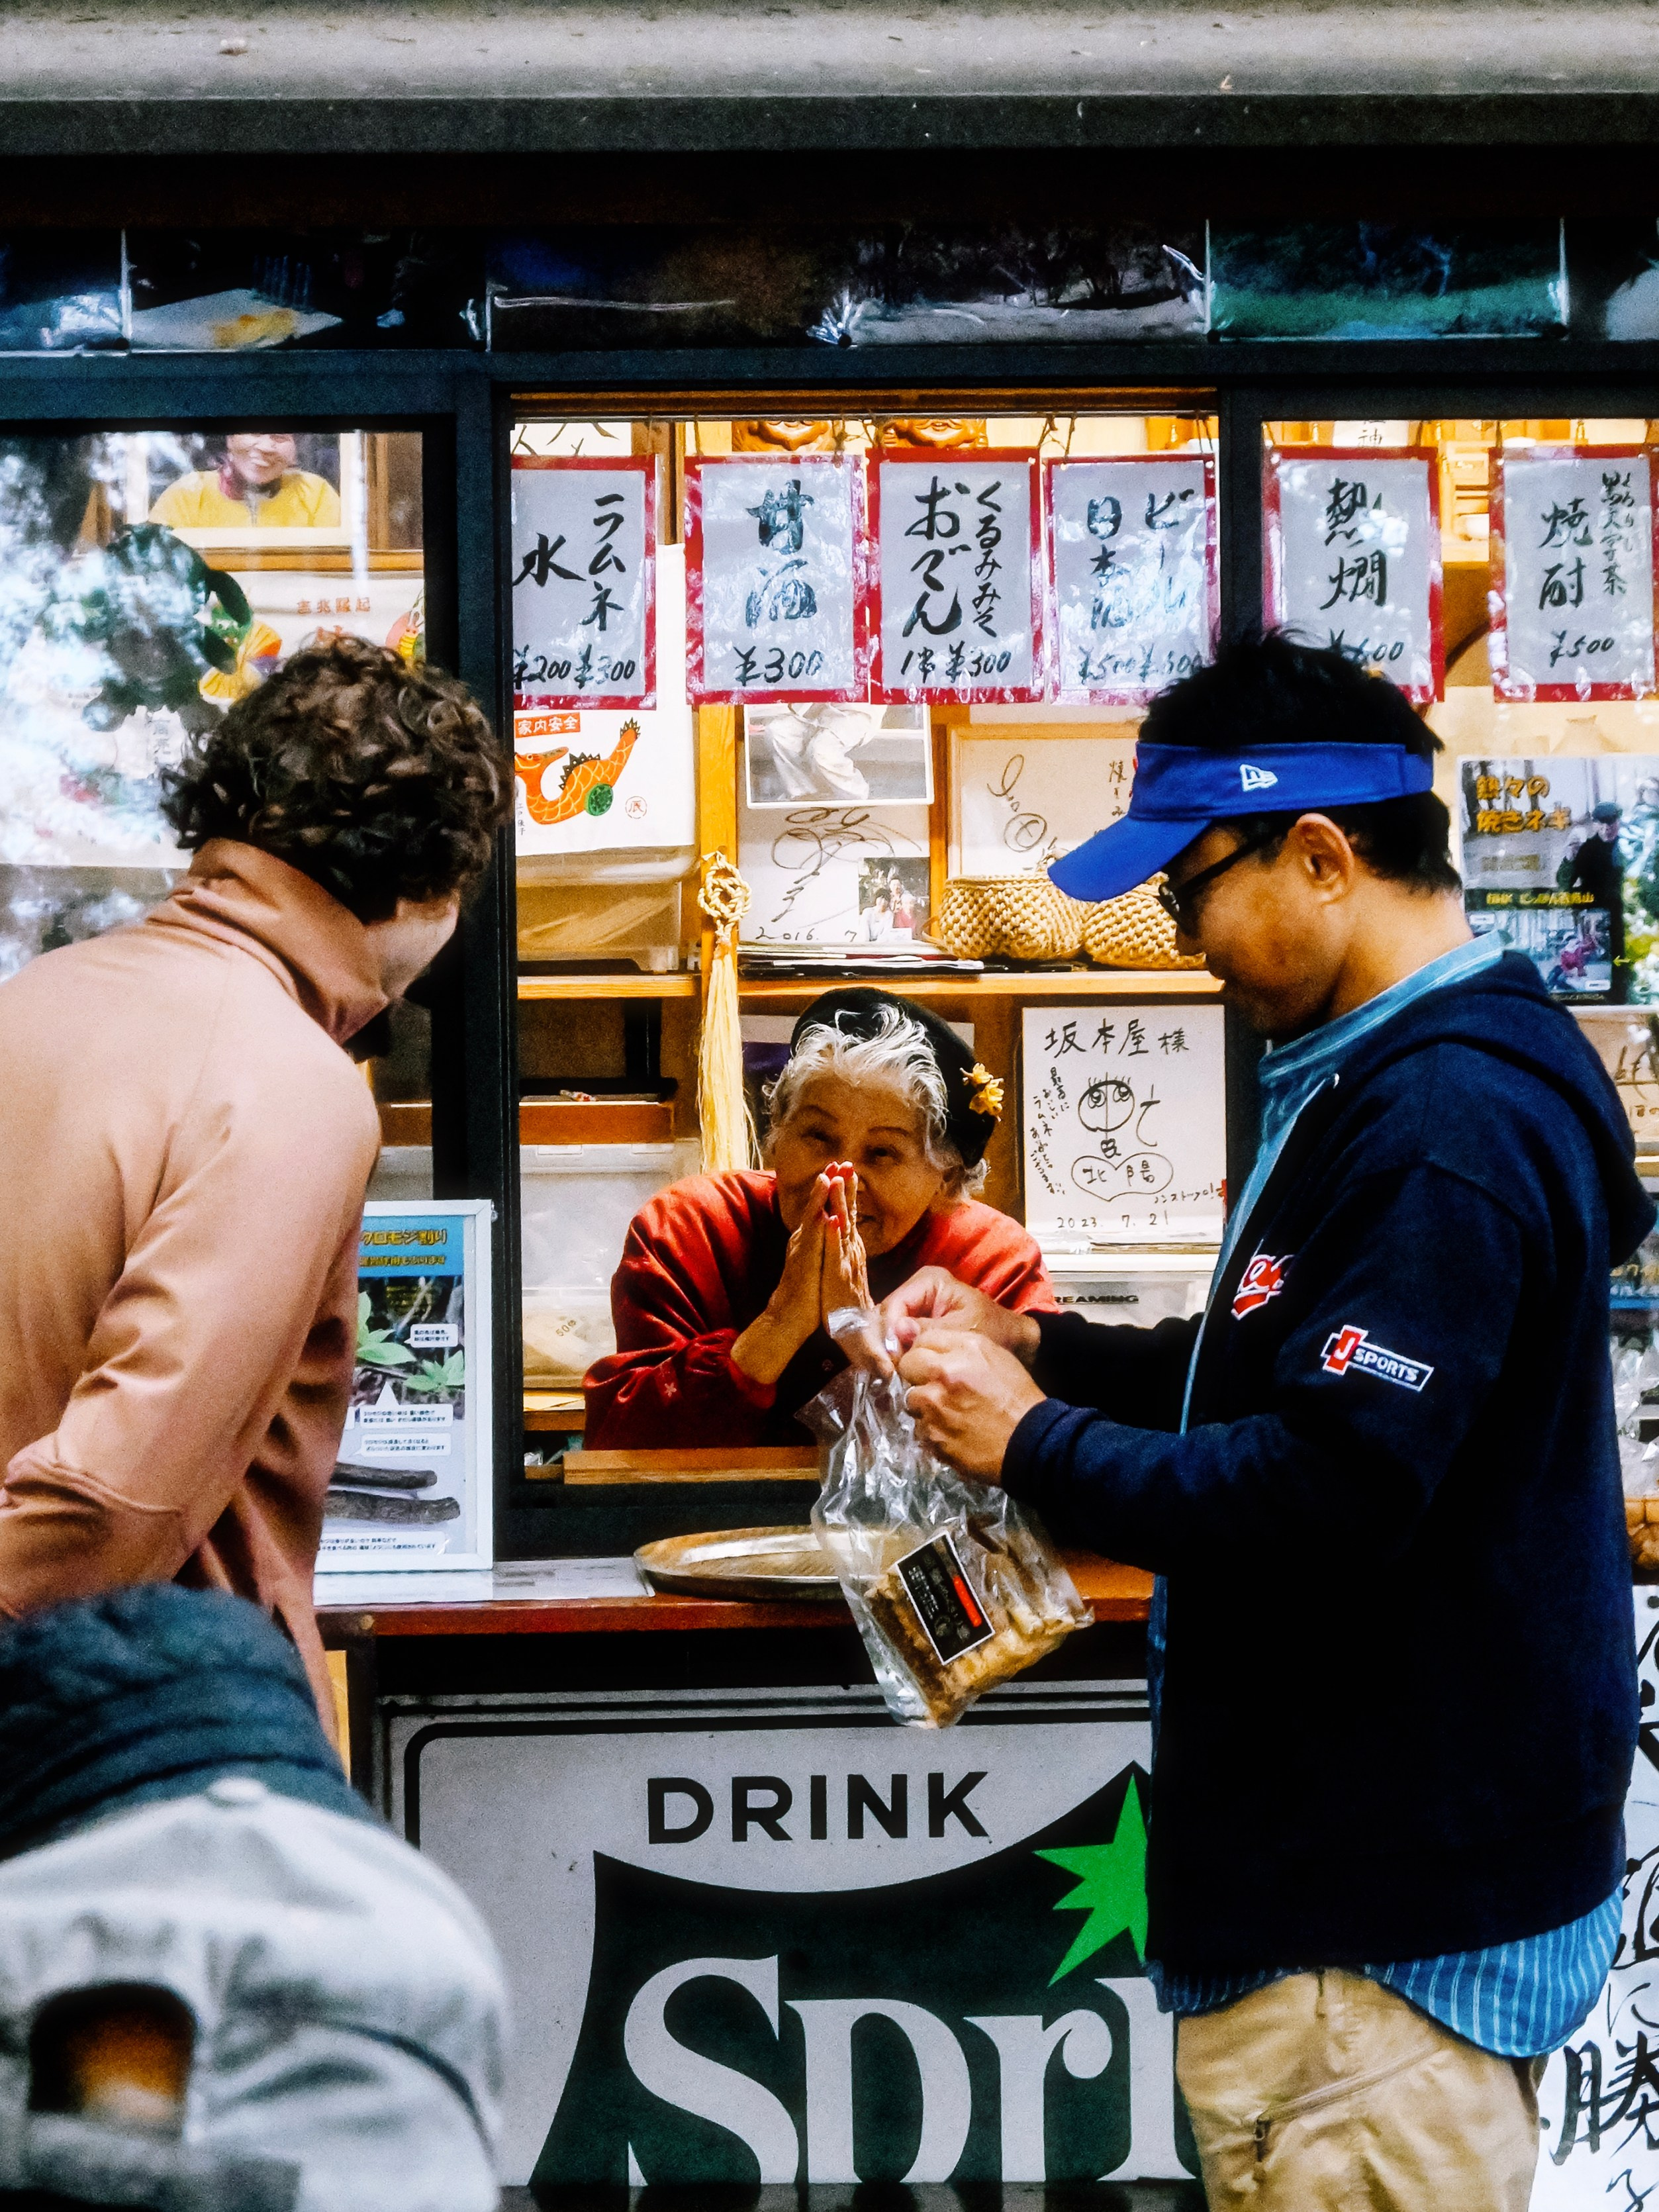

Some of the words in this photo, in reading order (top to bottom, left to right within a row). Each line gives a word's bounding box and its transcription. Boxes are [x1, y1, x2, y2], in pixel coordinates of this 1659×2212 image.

[512, 532, 587, 588] 水
[579, 493, 626, 632] ラムネ
[902, 475, 971, 638] おでん
[972, 481, 1002, 638] くるみみそ
[1539, 497, 1594, 610] 焼酎
[734, 646, 823, 687] ¥300
[1550, 630, 1615, 667] ¥500
[518, 714, 579, 736] 家内安全
[1044, 1018, 1190, 1059] 坂本屋様
[1353, 1347, 1419, 1382] SPORTS
[646, 1771, 990, 1845] DRINK
